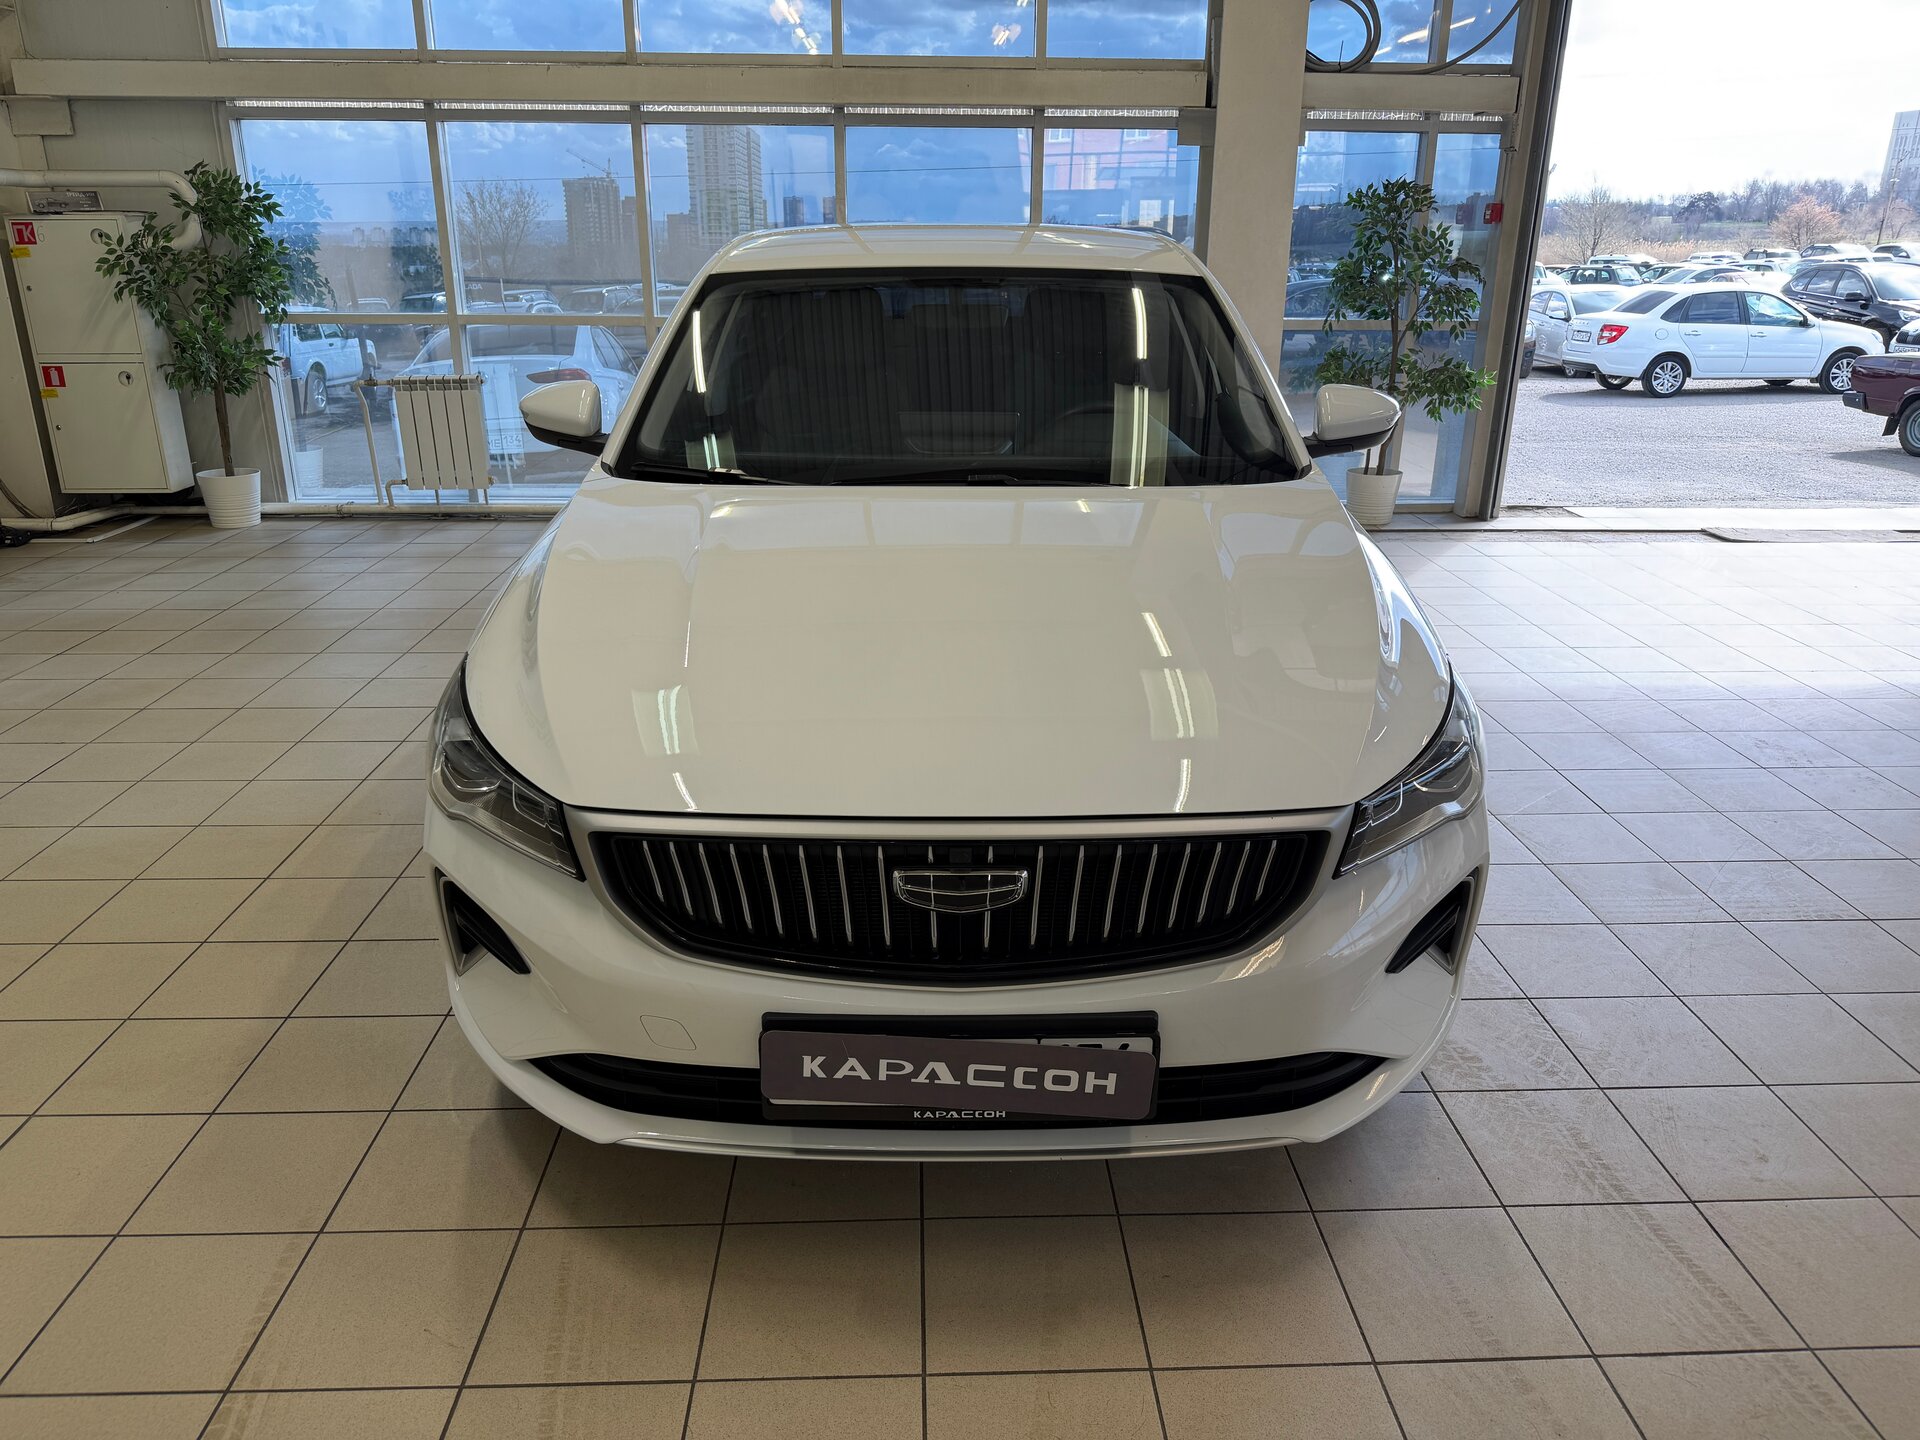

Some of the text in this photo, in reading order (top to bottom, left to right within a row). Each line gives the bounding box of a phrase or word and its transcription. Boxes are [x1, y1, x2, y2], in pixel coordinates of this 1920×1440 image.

[13, 224, 36, 242] ПК
[801, 1055, 1117, 1095] КАРАССОН
[913, 1110, 1006, 1119] КАРАССОН
